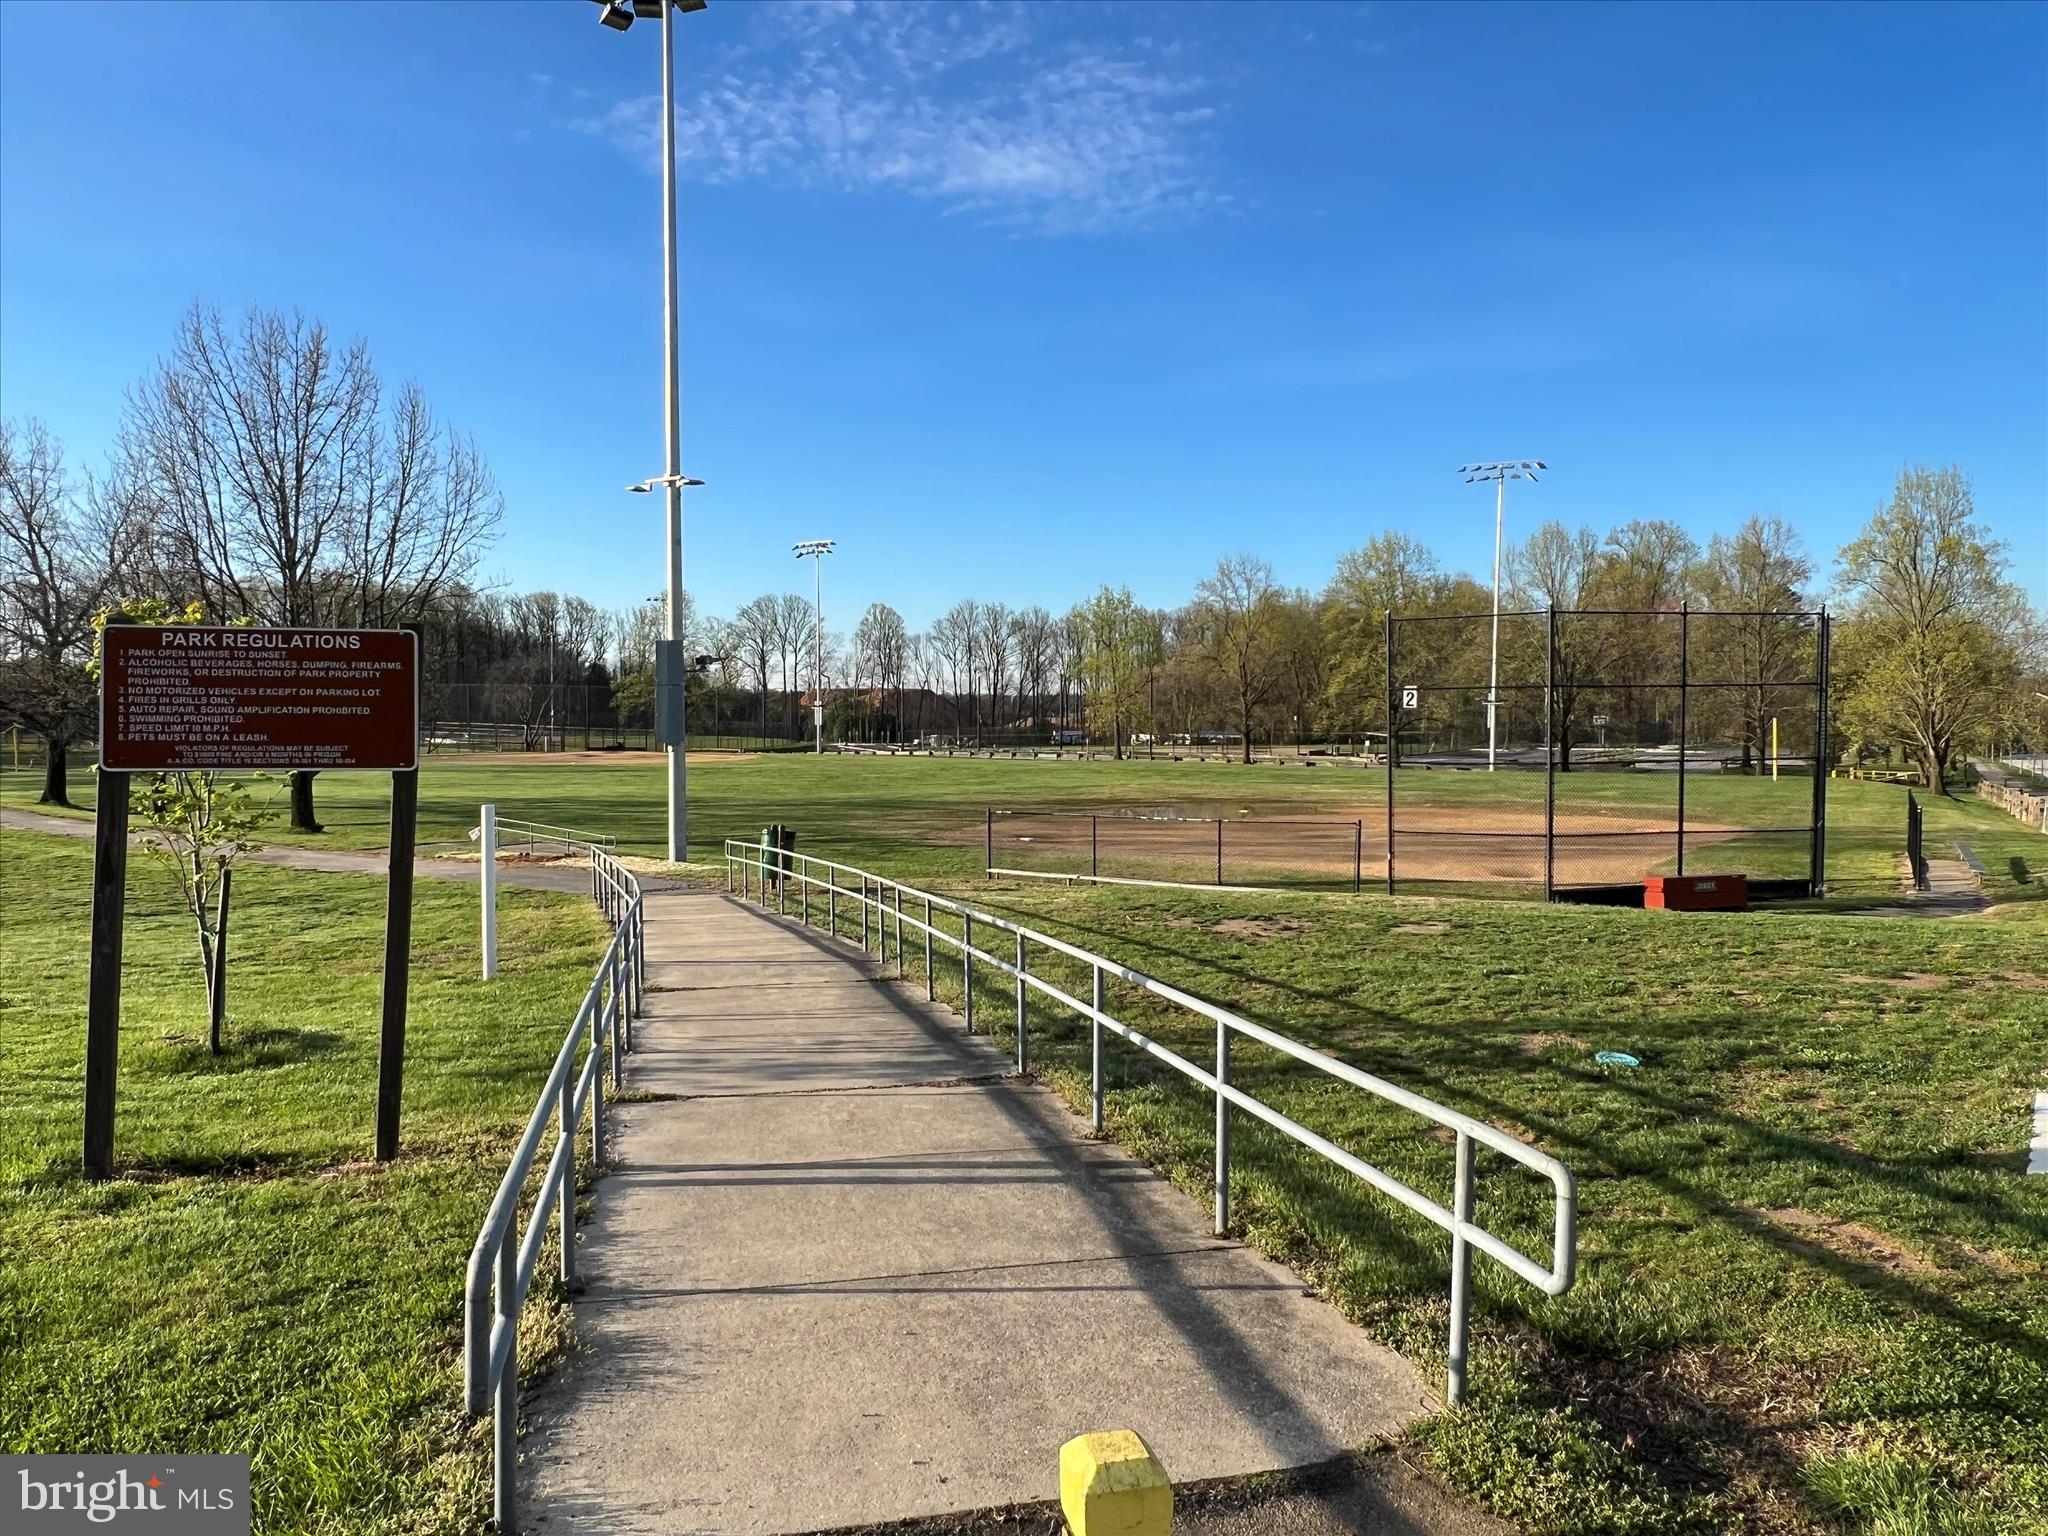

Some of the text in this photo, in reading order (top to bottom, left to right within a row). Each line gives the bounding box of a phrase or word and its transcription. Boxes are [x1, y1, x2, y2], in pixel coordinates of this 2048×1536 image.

[162, 632, 361, 649] PARK REGULATIONS
[128, 648, 156, 657] PARK
[158, 649, 186, 658] OPEN
[188, 650, 230, 658] SUNRISE
[128, 658, 188, 667] ALCOHOLIC
[211, 668, 281, 677] DESTRUCTION
[300, 670, 326, 678] PARK
[328, 670, 381, 678] PROPERTY
[146, 686, 206, 695] MOTORIZED
[208, 688, 256, 696] VEHICLES
[259, 688, 298, 696] EXCEPT
[316, 688, 360, 696] PARKING
[128, 696, 158, 704] FIRES
[172, 696, 208, 704] GRILLS
[1406, 692, 1415, 706] 2
[128, 706, 157, 714] AUTO
[200, 706, 235, 714] SOUND
[236, 706, 310, 714] AMPLIFICATION
[129, 714, 181, 722] SWIMMING
[129, 724, 162, 732] SPEED
[164, 724, 190, 732] LIMIT
[128, 733, 155, 741] PETS
[158, 733, 187, 741] MUST
